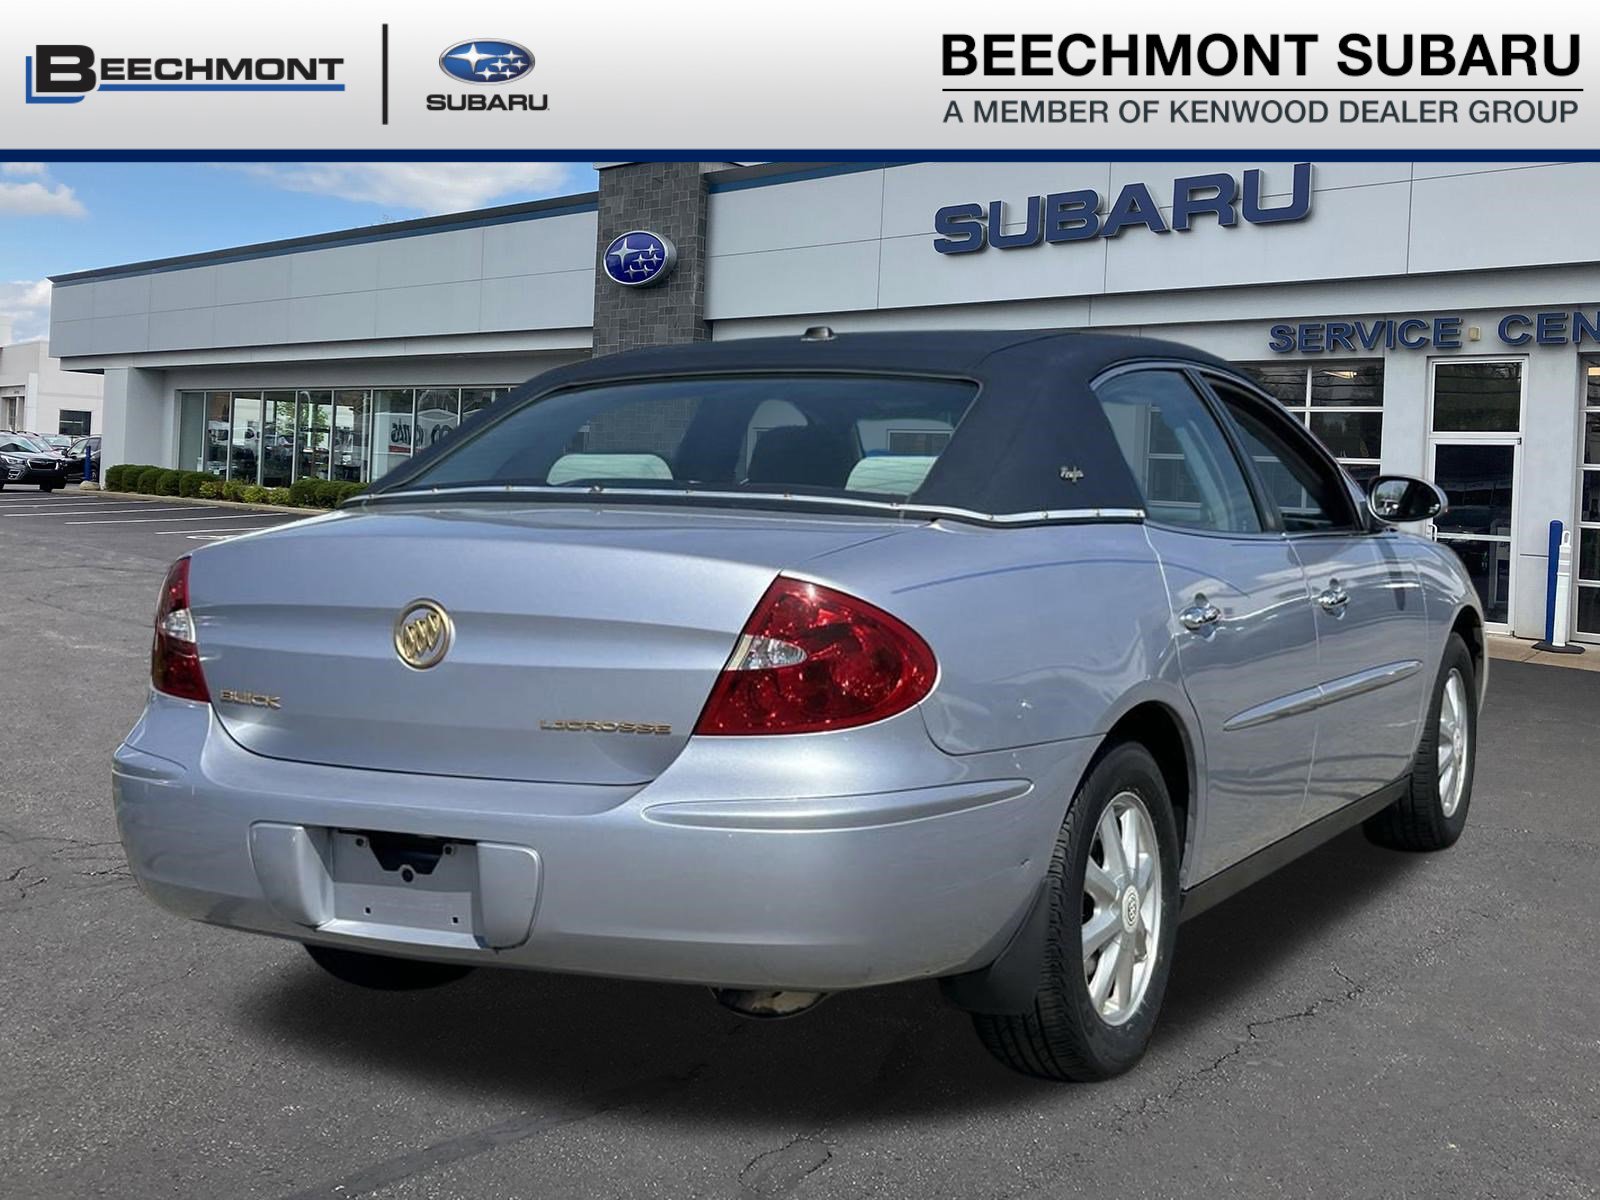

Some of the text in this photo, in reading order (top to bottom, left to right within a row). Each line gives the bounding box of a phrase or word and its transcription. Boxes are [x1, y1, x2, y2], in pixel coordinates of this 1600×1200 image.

[933, 163, 1312, 254] SUBARU
[1269, 317, 1463, 353] SERVICE
[220, 688, 281, 709] BUICK
[539, 719, 672, 735] LACROSSE
